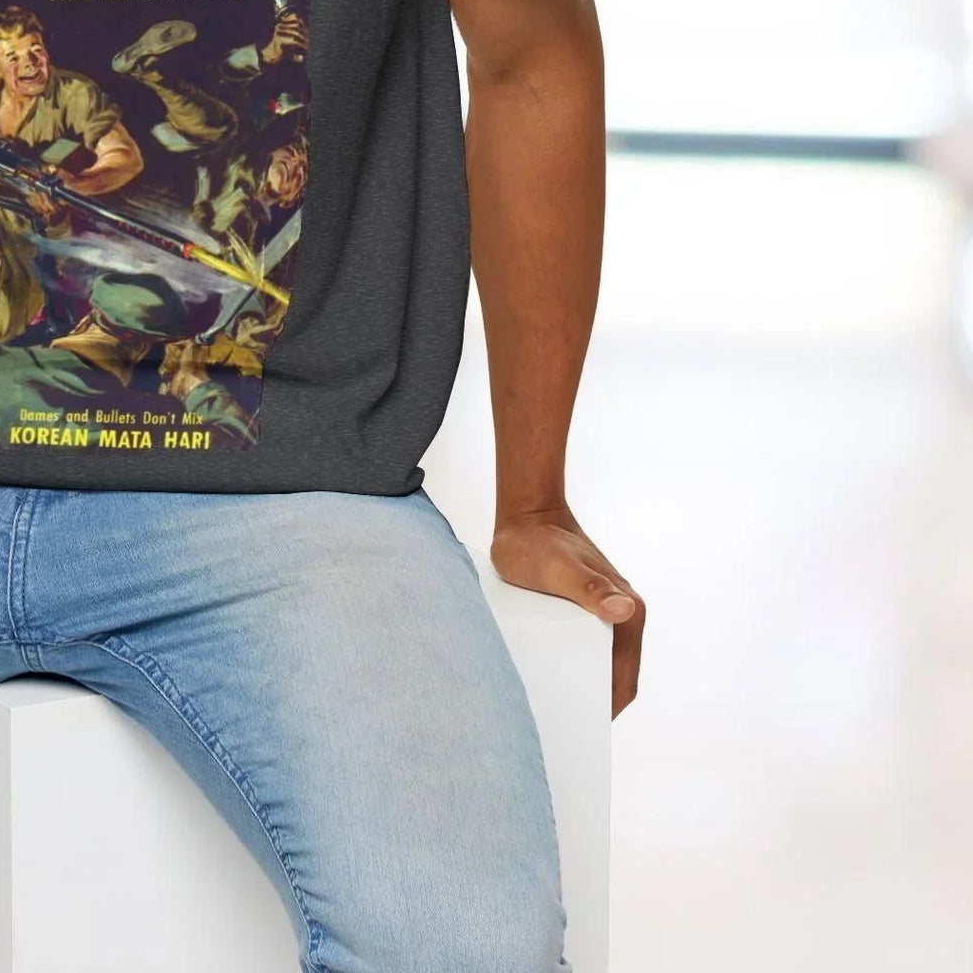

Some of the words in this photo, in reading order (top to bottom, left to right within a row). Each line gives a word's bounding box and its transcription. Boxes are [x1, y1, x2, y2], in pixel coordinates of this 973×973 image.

[19, 408, 60, 423] Dames
[66, 409, 89, 423] and
[95, 410, 137, 425] Bullets
[143, 411, 176, 425] Don't
[181, 411, 203, 425] Mix
[10, 427, 89, 447] KOREAN
[98, 430, 153, 449] MATA
[163, 431, 211, 450] HARI
